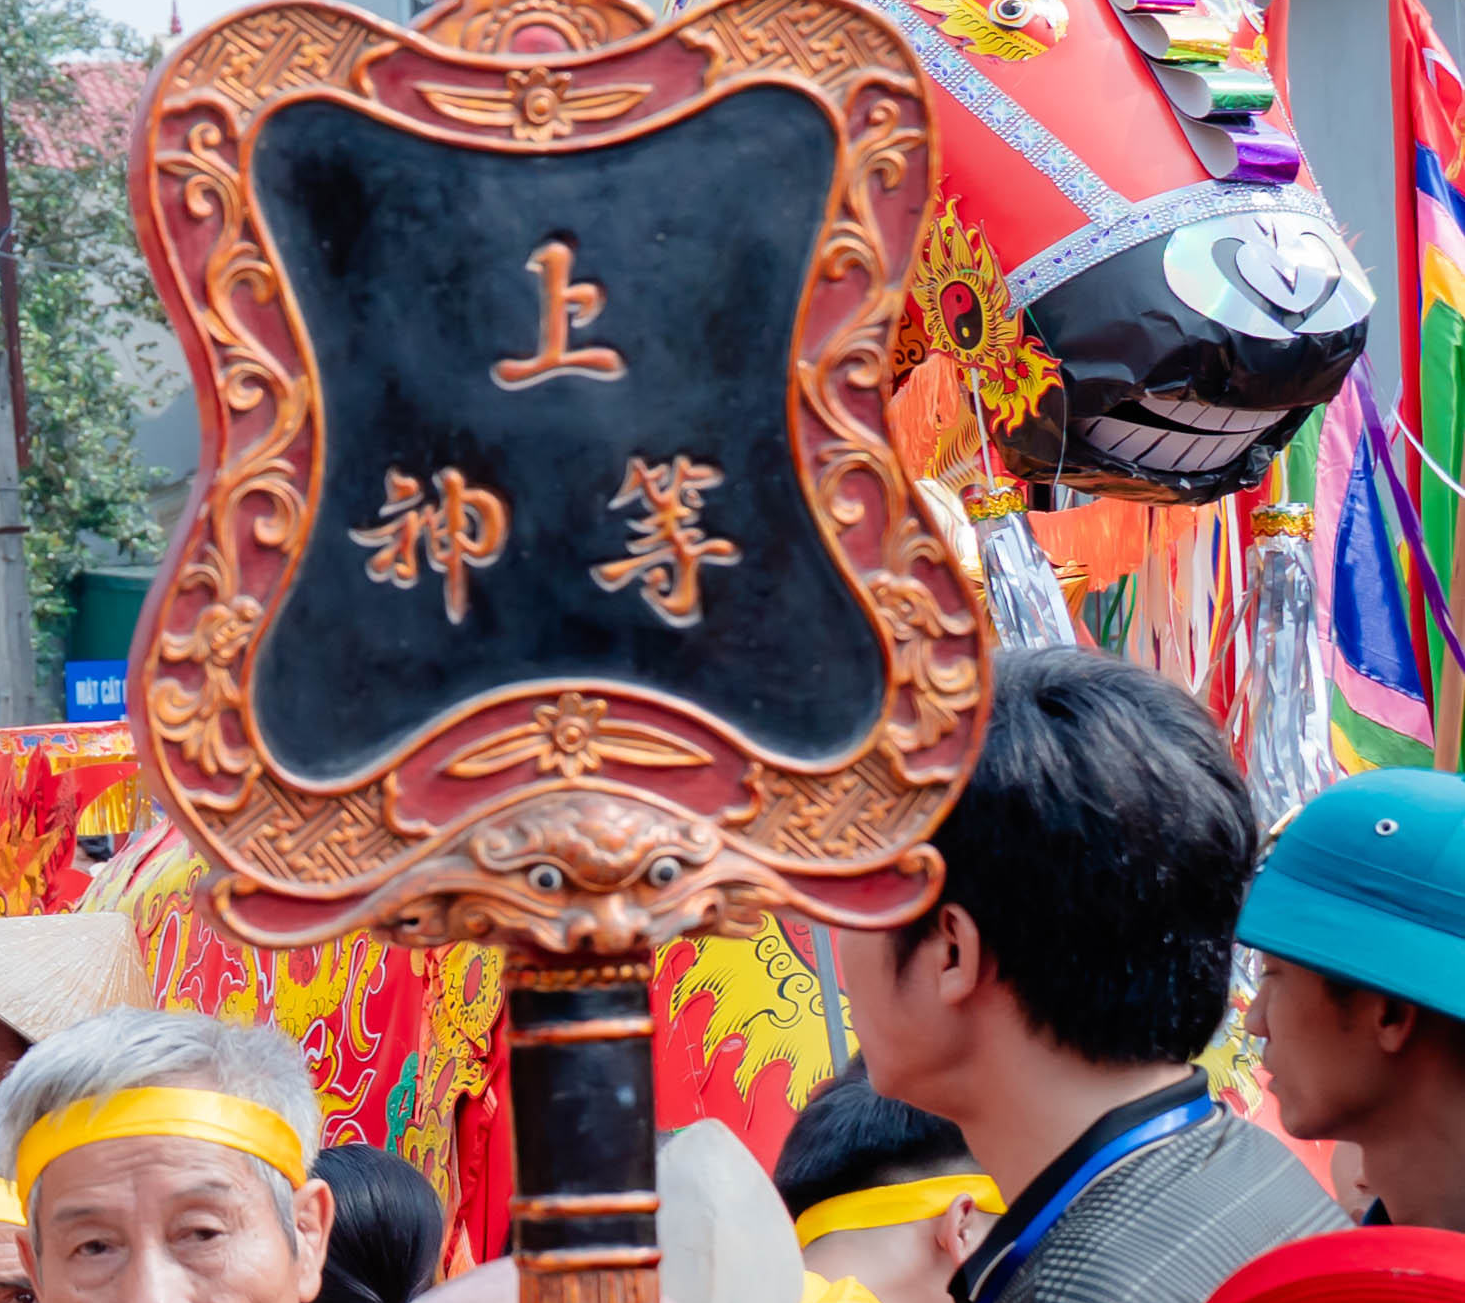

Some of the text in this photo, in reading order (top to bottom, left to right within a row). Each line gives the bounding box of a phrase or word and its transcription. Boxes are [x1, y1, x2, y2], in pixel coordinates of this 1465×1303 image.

[489, 239, 627, 392] 上
[348, 466, 511, 627] 神
[590, 454, 742, 630] 等
